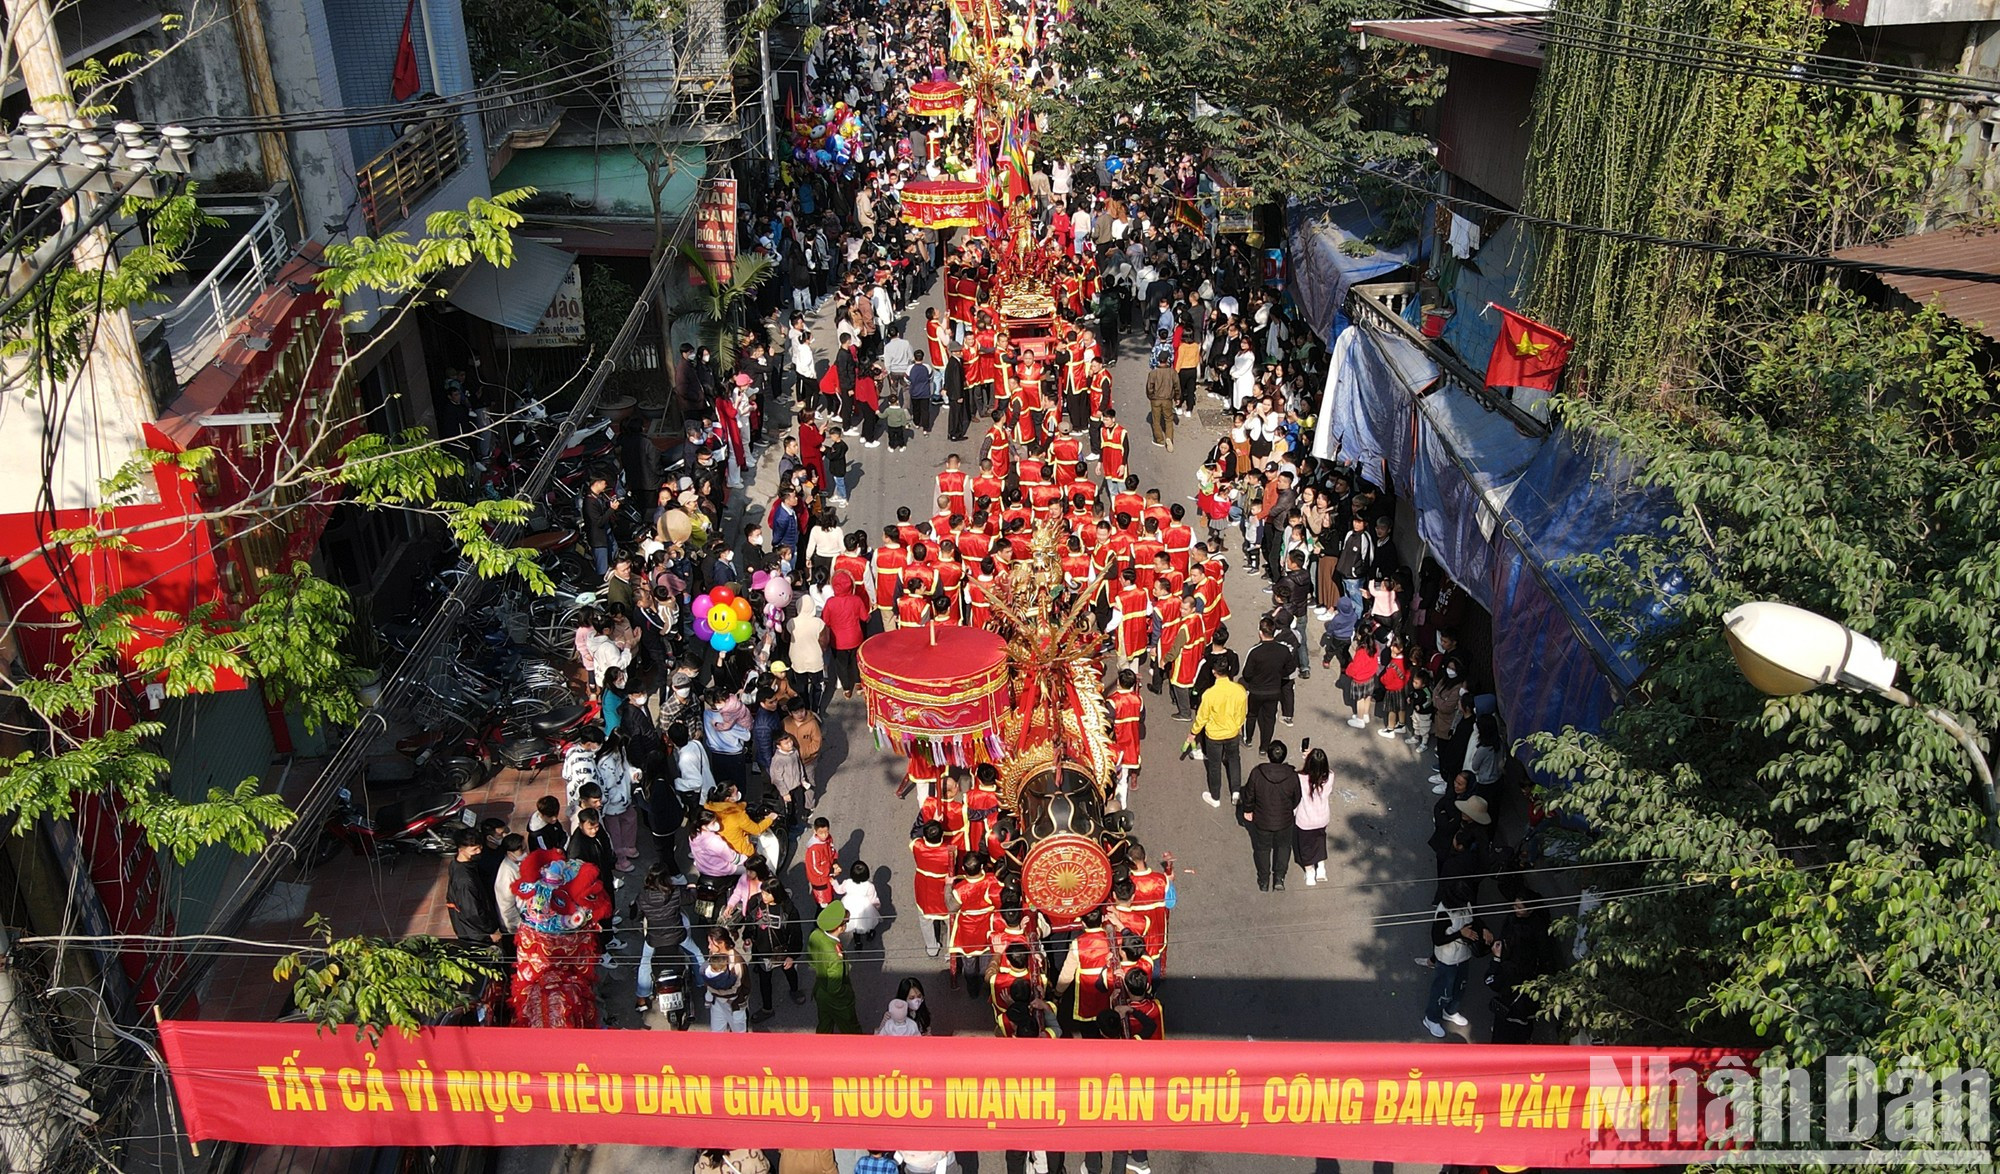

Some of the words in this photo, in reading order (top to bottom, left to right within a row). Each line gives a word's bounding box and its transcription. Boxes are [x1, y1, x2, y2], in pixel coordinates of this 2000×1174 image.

[257, 1050, 327, 1111] TẤT
[337, 1052, 393, 1111] CẢ
[397, 1060, 438, 1111] VÌ
[445, 1070, 532, 1122] MỤC
[541, 1063, 623, 1113] TIÊU
[635, 1065, 712, 1115] DÂN
[723, 1067, 821, 1122] GIÀU,
[833, 1069, 933, 1119] NƯỚC
[945, 1077, 1066, 1129] MẠNH,
[1079, 1073, 1155, 1121] DÂN
[1167, 1069, 1249, 1128] CHỦ,
[1263, 1073, 1364, 1124] CÔNG
[1500, 1073, 1575, 1129] VĂN
